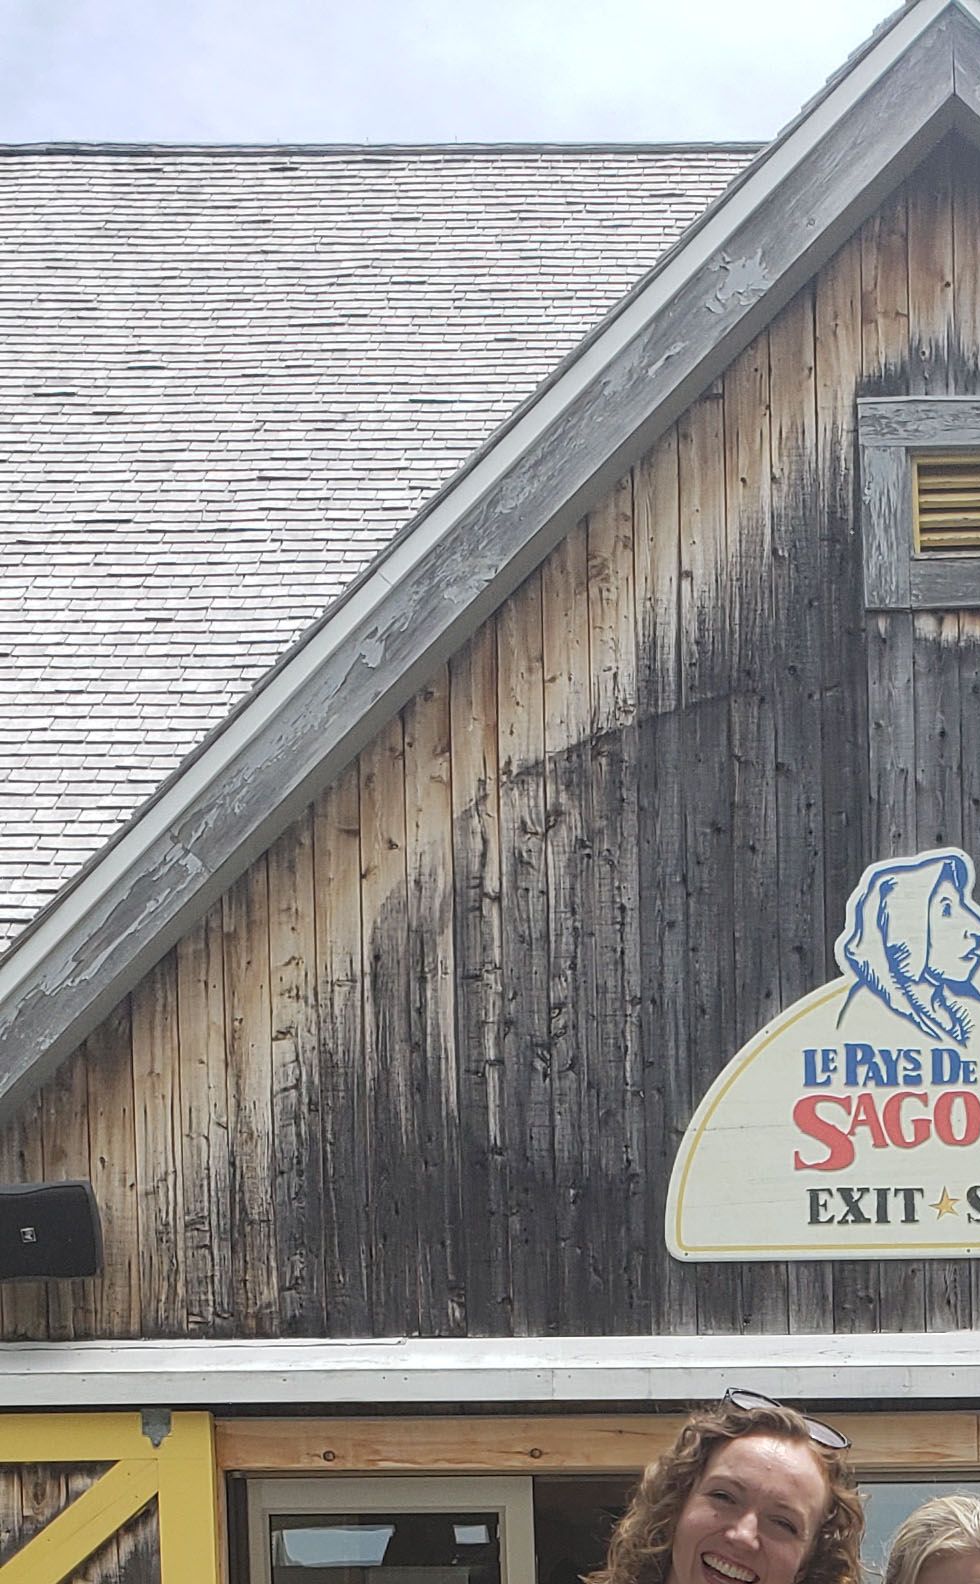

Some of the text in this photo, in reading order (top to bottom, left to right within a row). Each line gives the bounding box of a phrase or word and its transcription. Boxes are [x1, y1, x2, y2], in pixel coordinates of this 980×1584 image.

[802, 1048, 838, 1087] LE
[843, 1042, 922, 1087] PAYS
[930, 1047, 978, 1086] DE
[806, 1187, 924, 1225] EXIT
